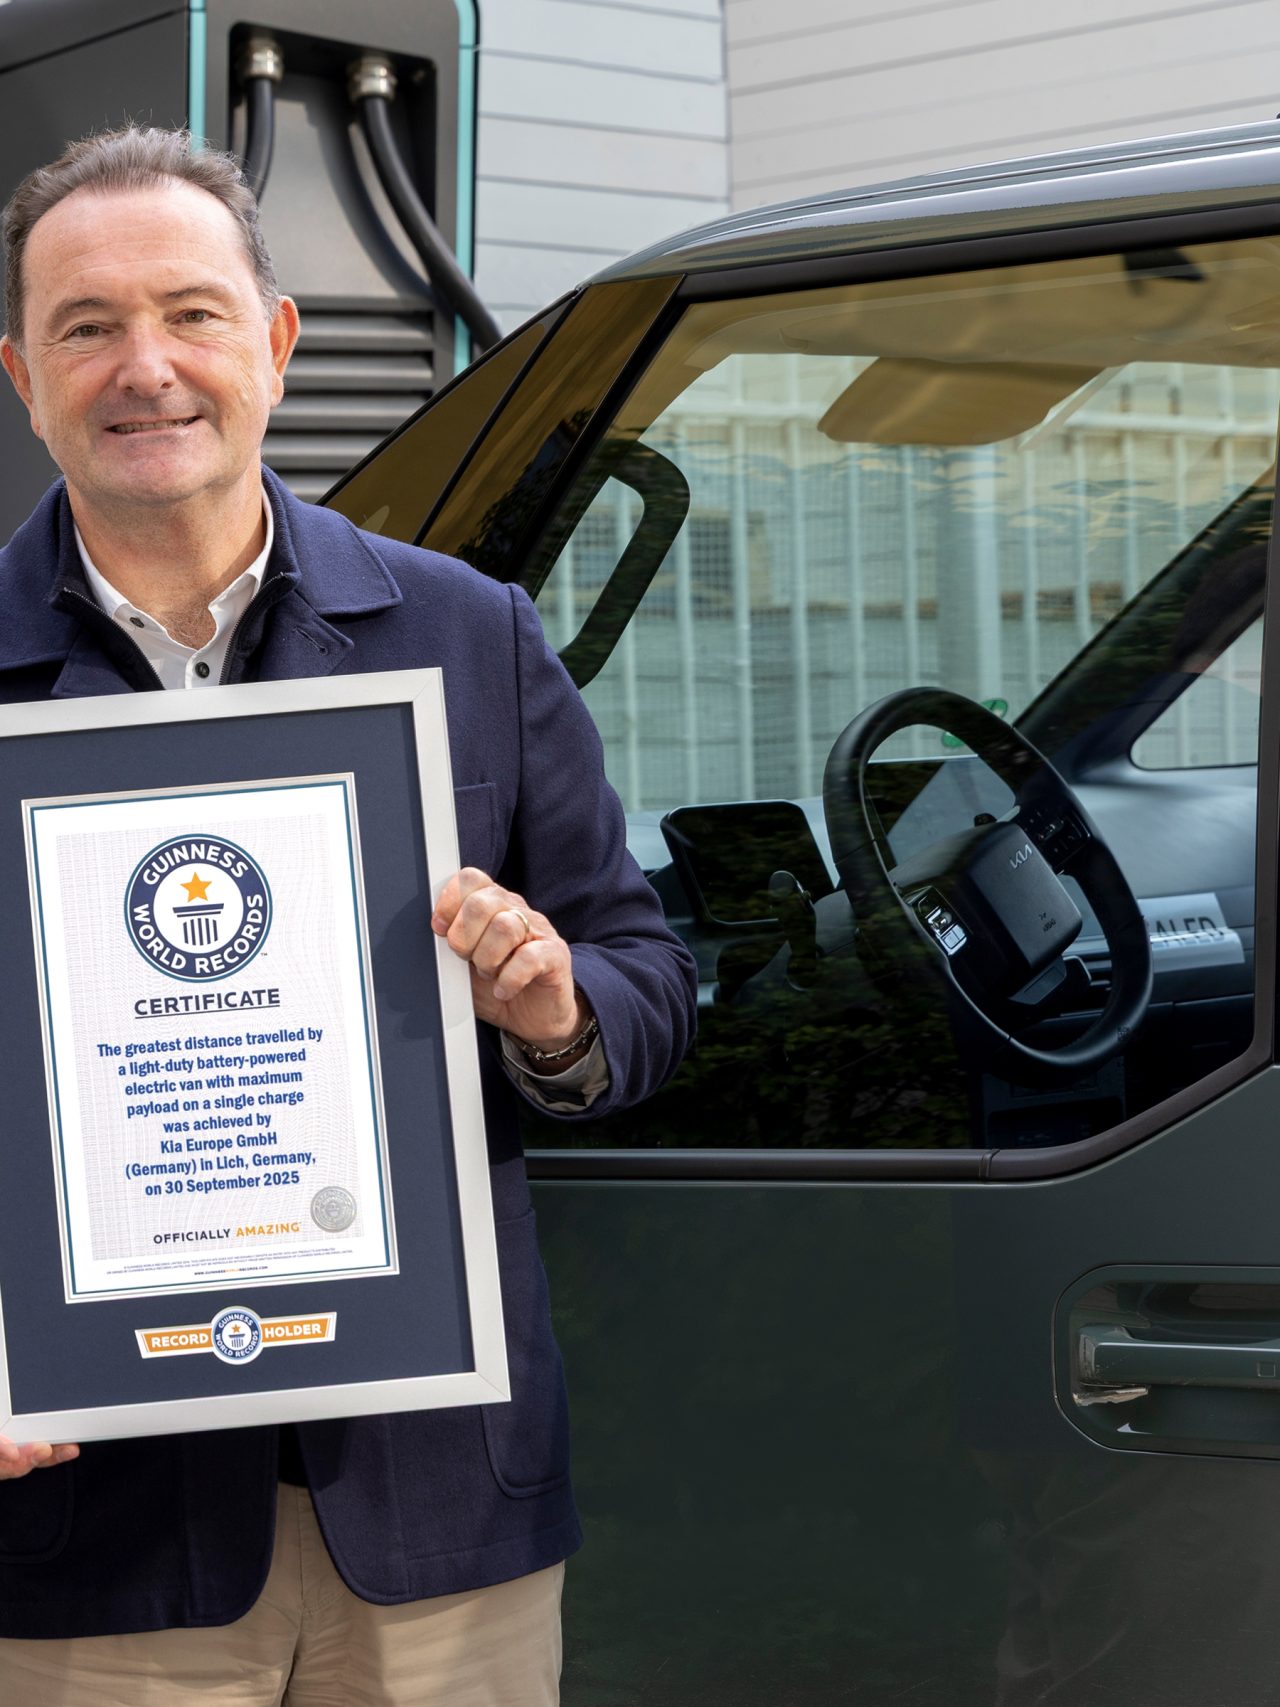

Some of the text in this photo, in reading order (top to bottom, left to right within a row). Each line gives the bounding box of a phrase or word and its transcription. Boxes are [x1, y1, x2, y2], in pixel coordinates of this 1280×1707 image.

[142, 843, 249, 886] GUINNESS
[133, 894, 264, 974] WORLD RECORDS
[134, 988, 281, 1016] CERTIFICATE
[97, 1027, 323, 1057] The greatest distance travelled by
[118, 1048, 306, 1077] a light-duty battery-powered
[125, 1071, 303, 1095] electric van with maximum
[127, 1092, 304, 1119] payload on a single charge
[163, 1113, 272, 1133] was achieved by
[161, 1132, 277, 1153] Kia Europe GmbH
[125, 1151, 316, 1180] (Germany) in Lich, Germany,
[145, 1171, 300, 1196] on 30 September 2025
[153, 1223, 300, 1245] OFFICIALLY AMAZING
[218, 1314, 254, 1329] GUINNESS
[265, 1323, 322, 1339] HOLDER
[151, 1332, 209, 1348] RECORD
[215, 1330, 258, 1357] WORLD RECORDS
